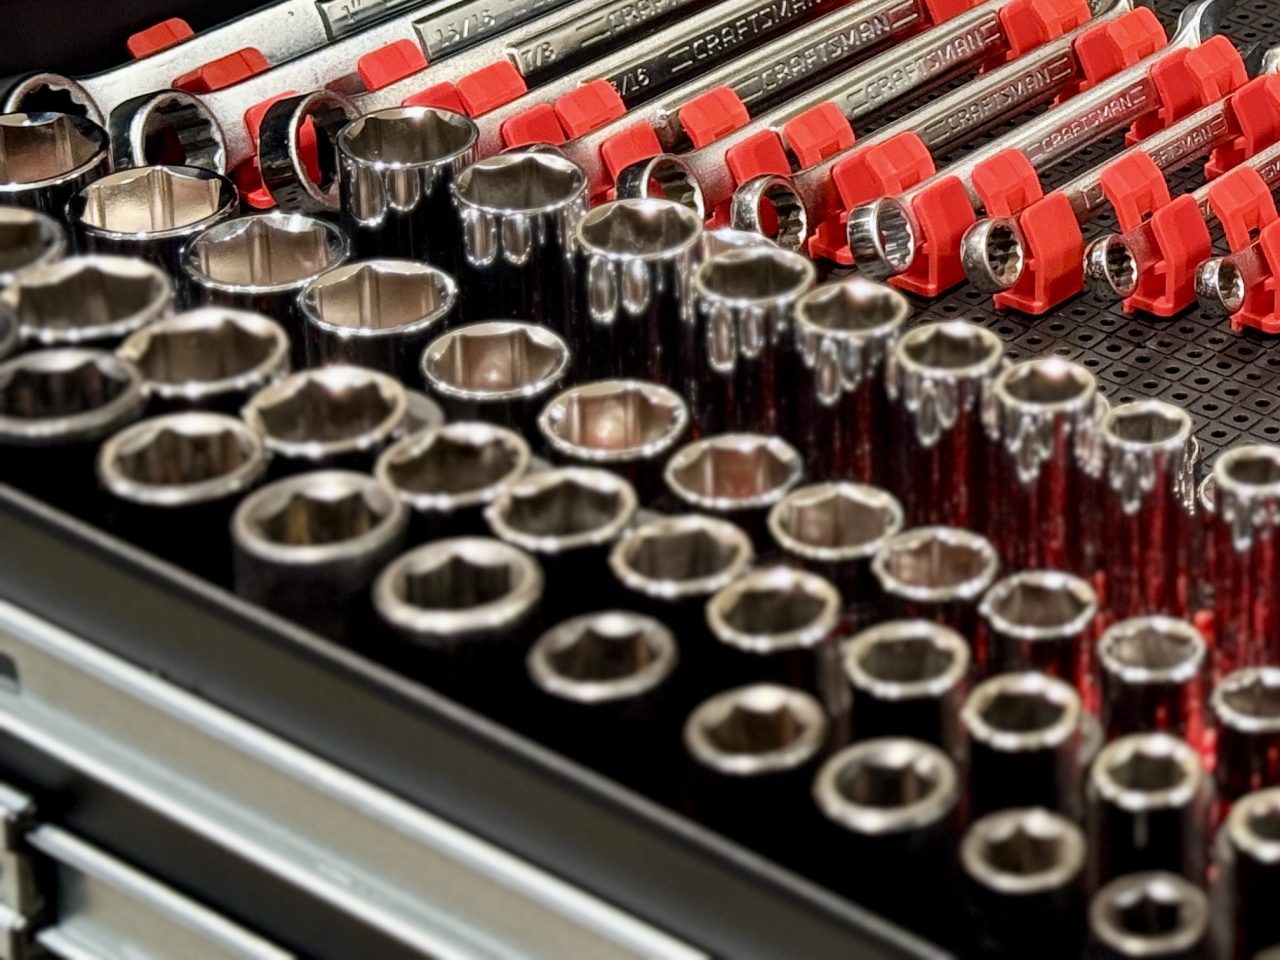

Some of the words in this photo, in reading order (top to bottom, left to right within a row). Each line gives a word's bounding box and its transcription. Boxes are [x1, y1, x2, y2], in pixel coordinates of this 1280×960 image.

[762, 13, 890, 90] CRAFTSMAN
[866, 29, 983, 100] CRAFTSMAN
[948, 67, 1051, 131] CRAFTSMAN
[1042, 94, 1132, 152] CRAFTSMAN
